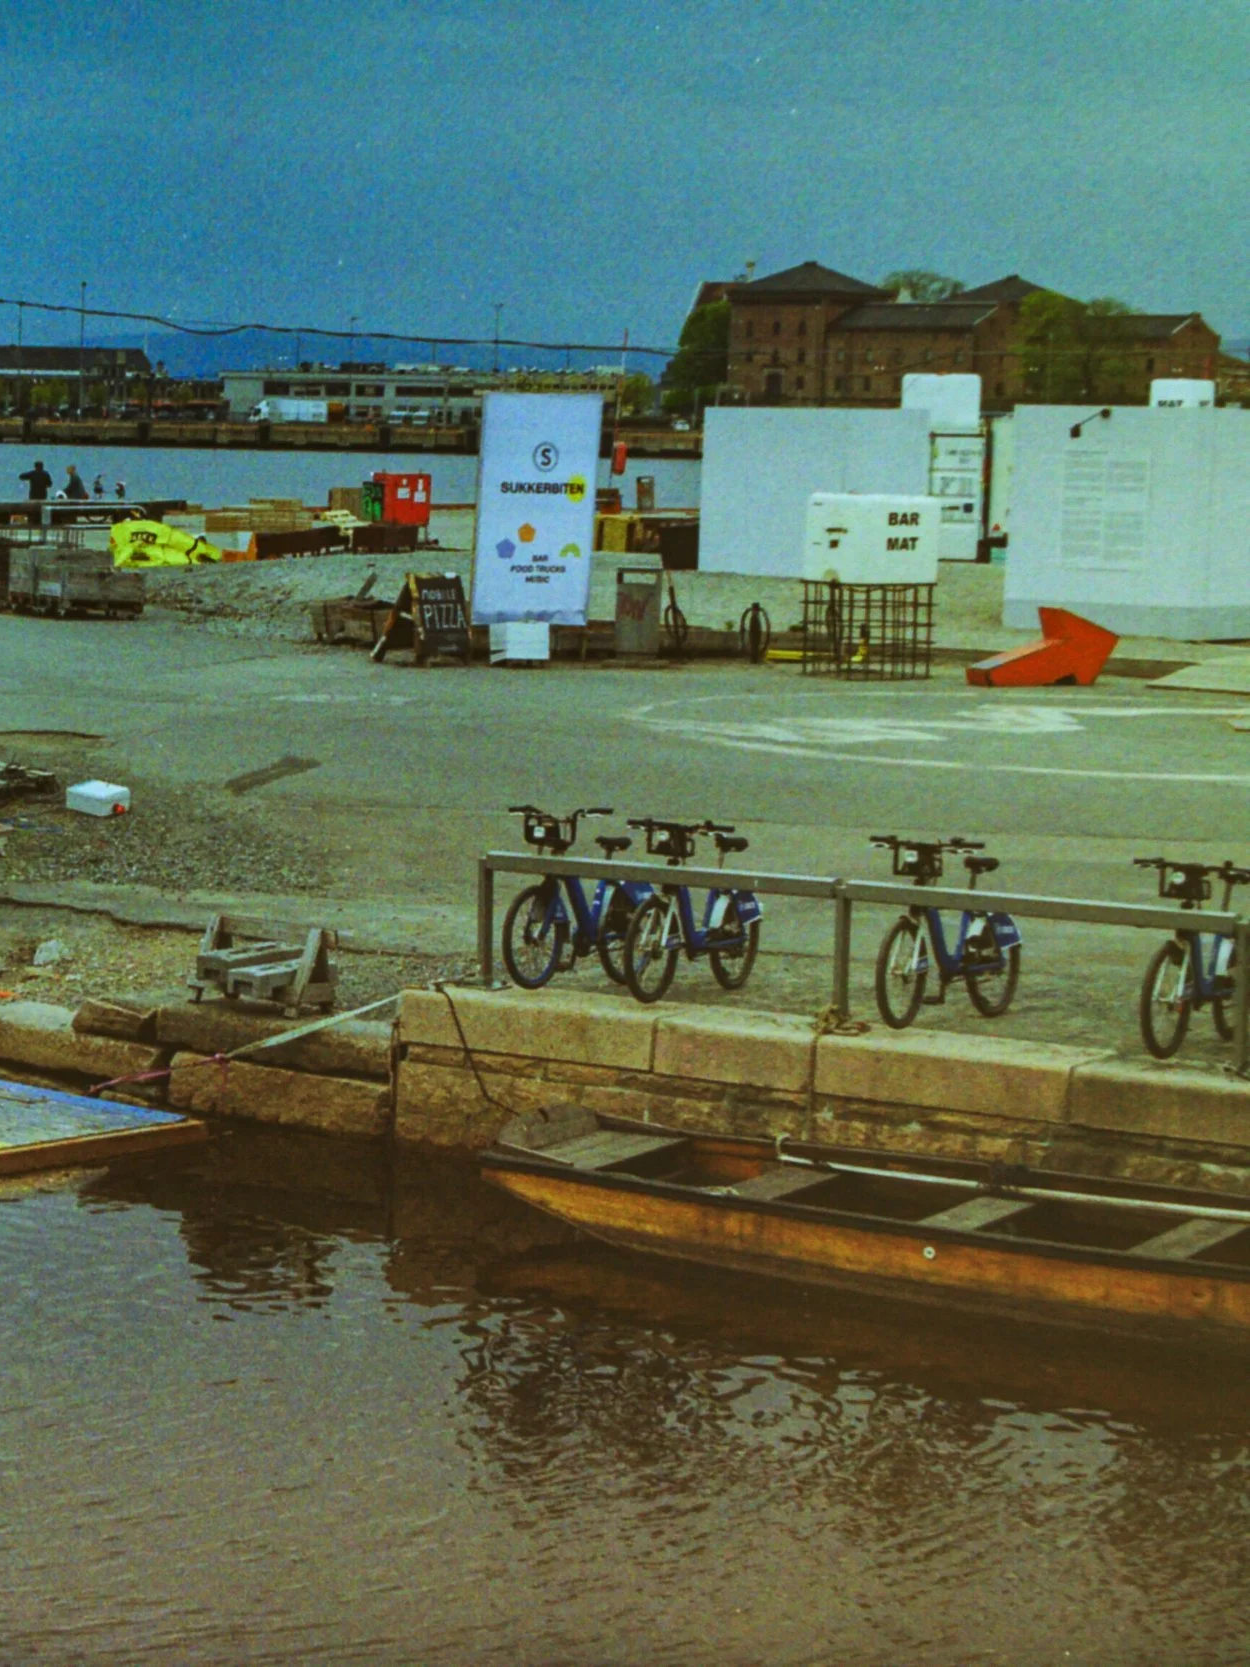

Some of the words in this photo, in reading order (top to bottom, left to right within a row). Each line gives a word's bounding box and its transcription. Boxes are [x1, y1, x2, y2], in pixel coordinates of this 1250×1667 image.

[541, 448, 552, 466] S
[501, 481, 584, 495] SUKKERBITEN
[888, 512, 919, 526] BAR
[886, 537, 918, 551] MAT
[511, 565, 534, 573] FOOD
[423, 603, 467, 629] PIZZA
